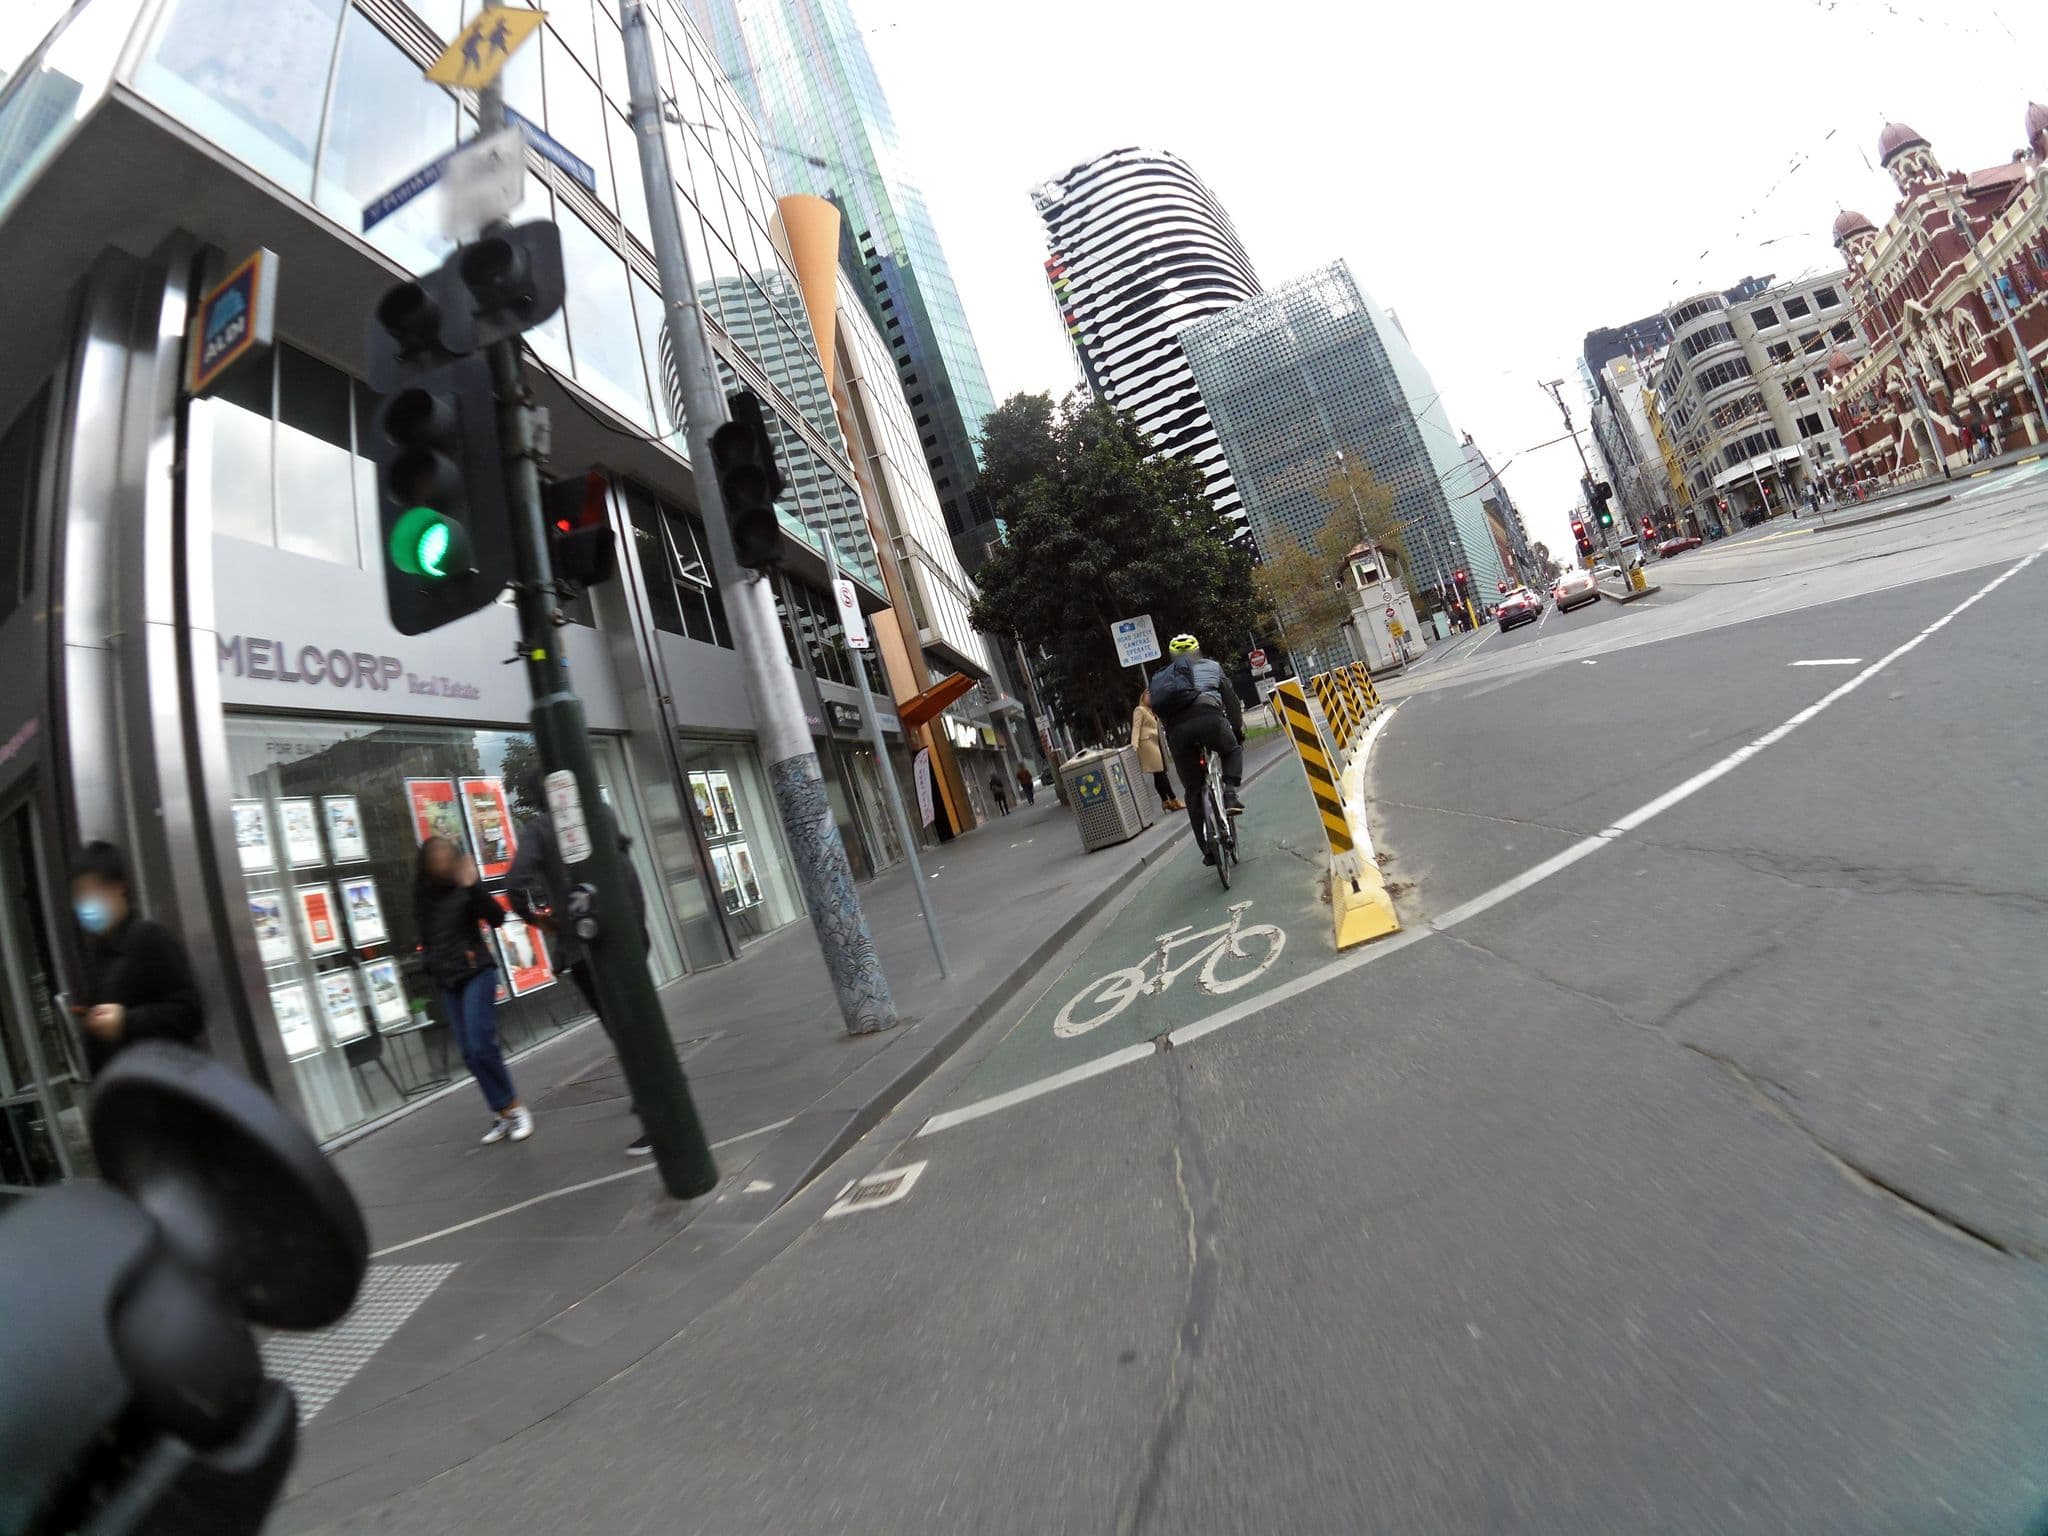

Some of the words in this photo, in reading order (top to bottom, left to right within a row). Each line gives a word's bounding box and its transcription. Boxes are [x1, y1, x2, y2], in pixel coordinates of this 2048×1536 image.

[204, 315, 245, 363] ALDI
[216, 632, 402, 691] MELCORP
[1123, 637, 1150, 649] CAMERAS
